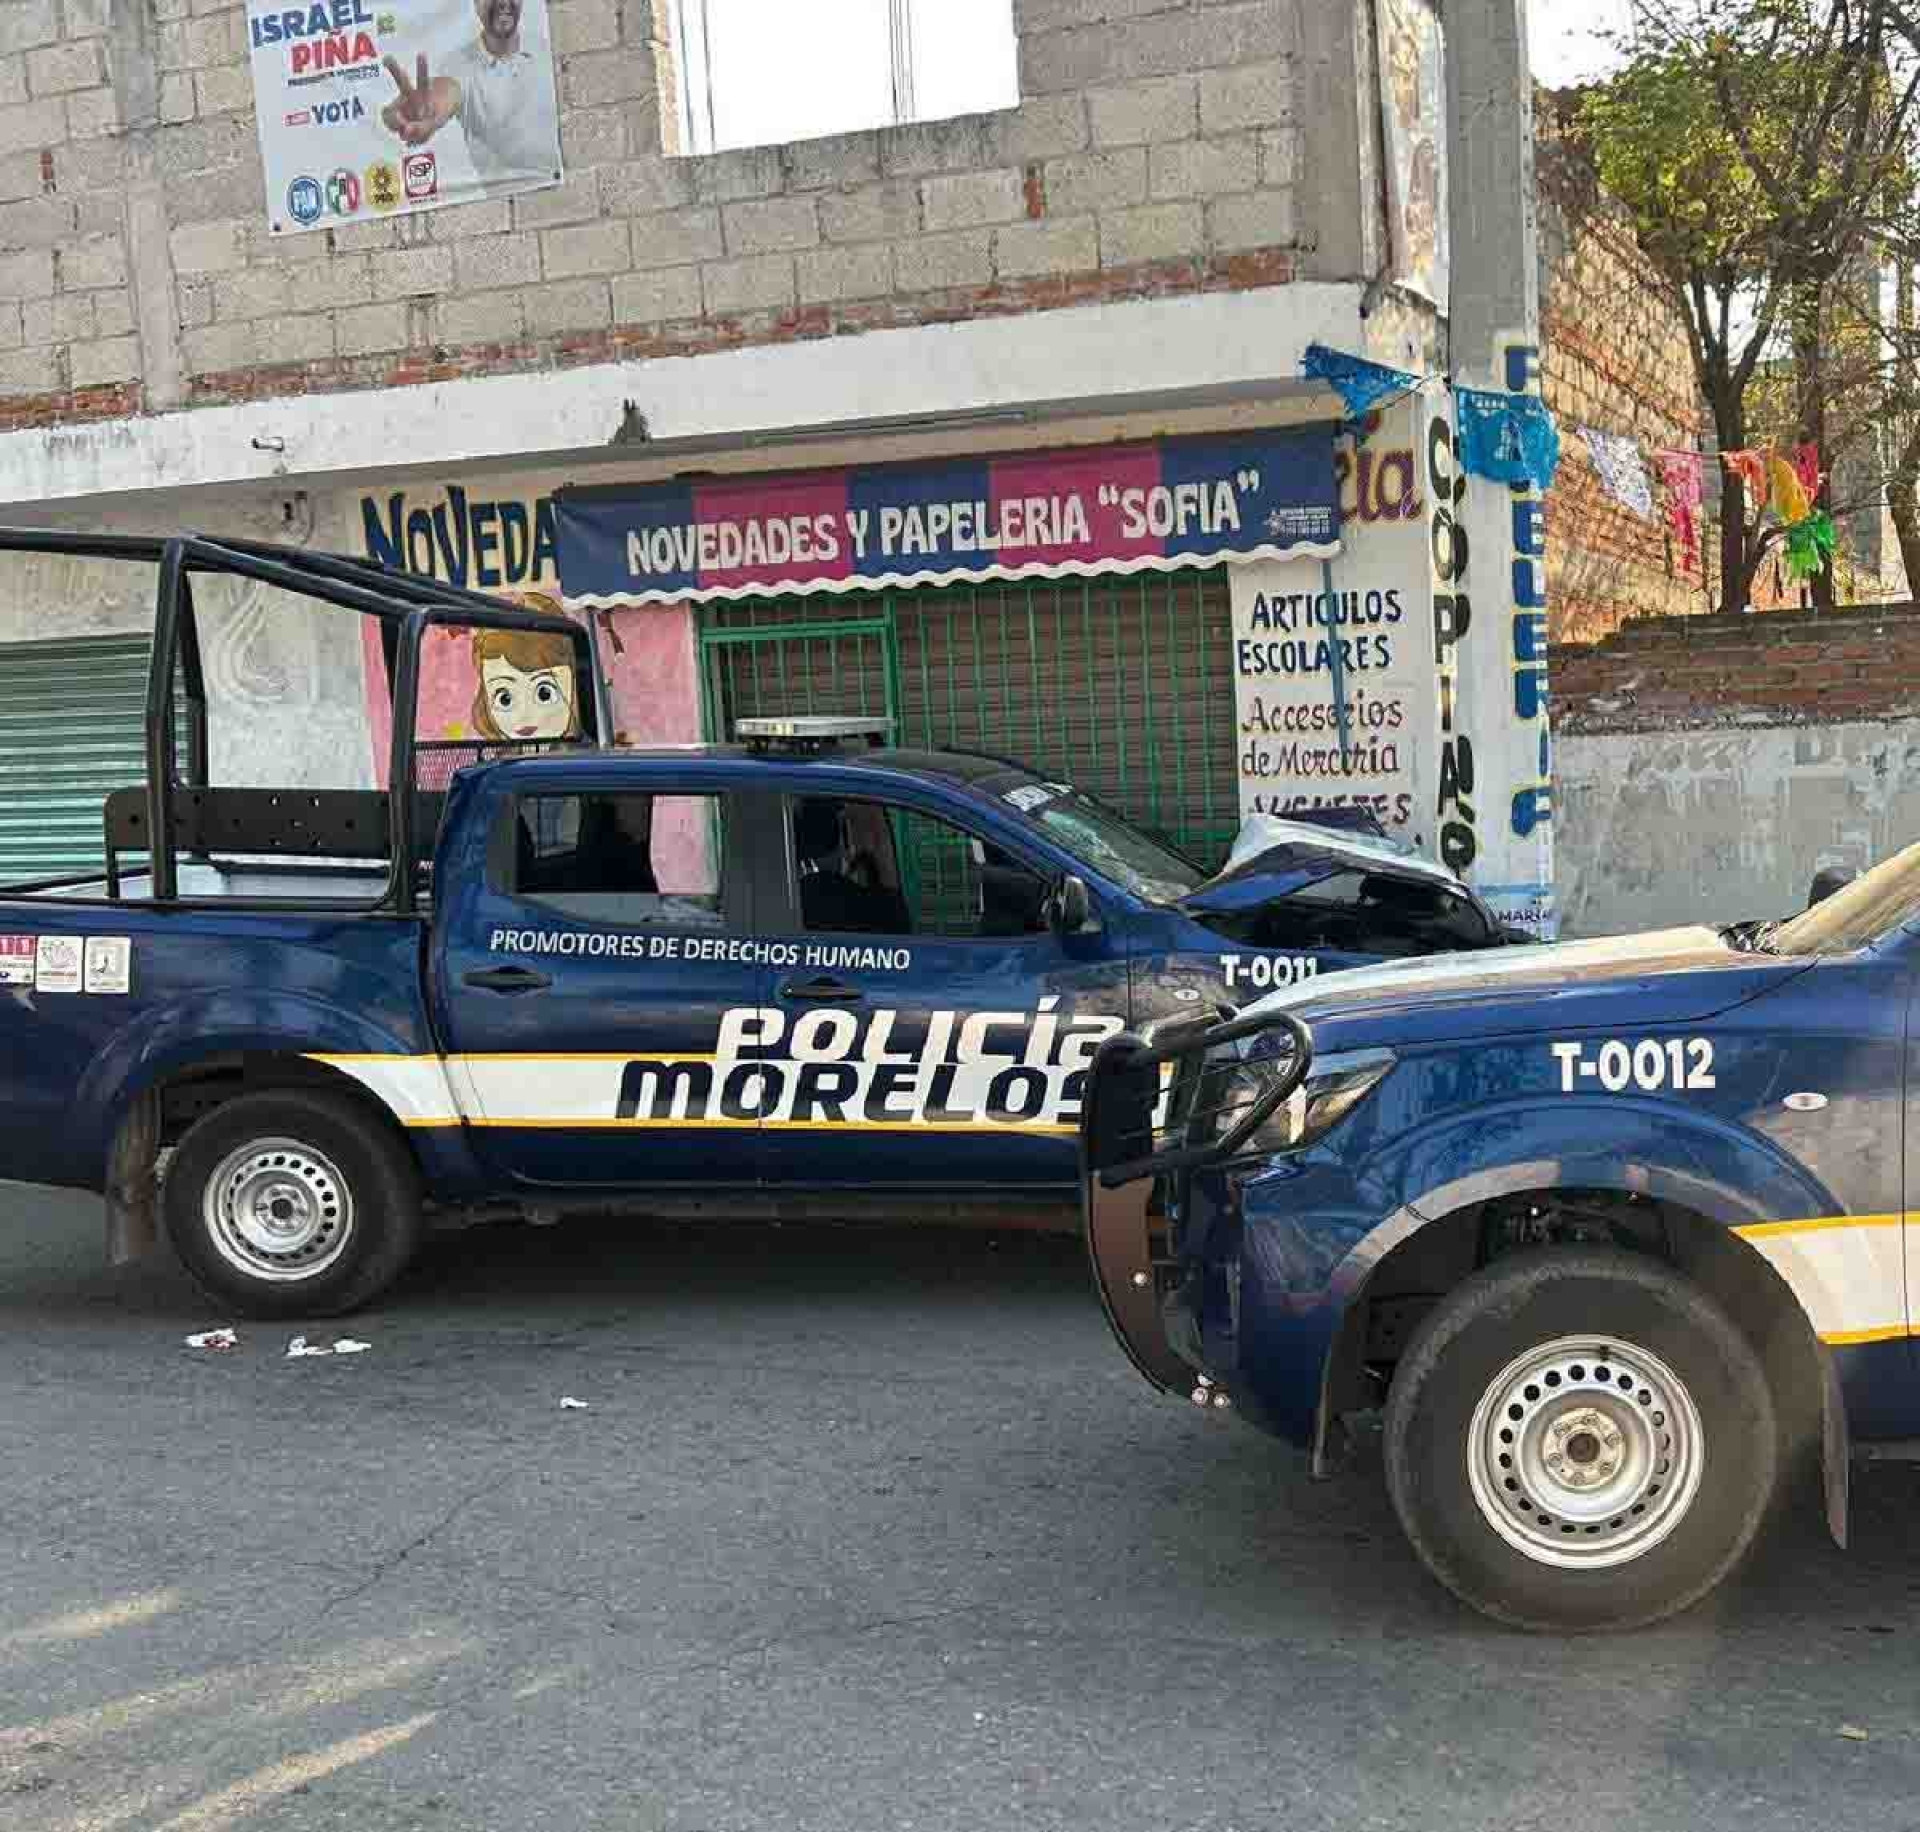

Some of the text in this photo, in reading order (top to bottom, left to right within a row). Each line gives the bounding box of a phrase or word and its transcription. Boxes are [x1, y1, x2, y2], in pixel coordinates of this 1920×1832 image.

[250, 0, 373, 49] ISRAEL
[291, 25, 377, 73] PIÑA
[311, 96, 364, 124] VOTA
[626, 515, 841, 577] NOVEDADES
[846, 511, 870, 559] Y
[881, 494, 1091, 555] PAPELERIA
[1252, 589, 1402, 632] ARTICULOS
[1237, 635, 1392, 675] ESCOLARES
[1241, 740, 1271, 777] de
[490, 930, 910, 970] PROMOTORES DE DERECHOS HUMANO
[1220, 954, 1318, 988] T-0011
[1551, 1037, 1716, 1092] T-0012
